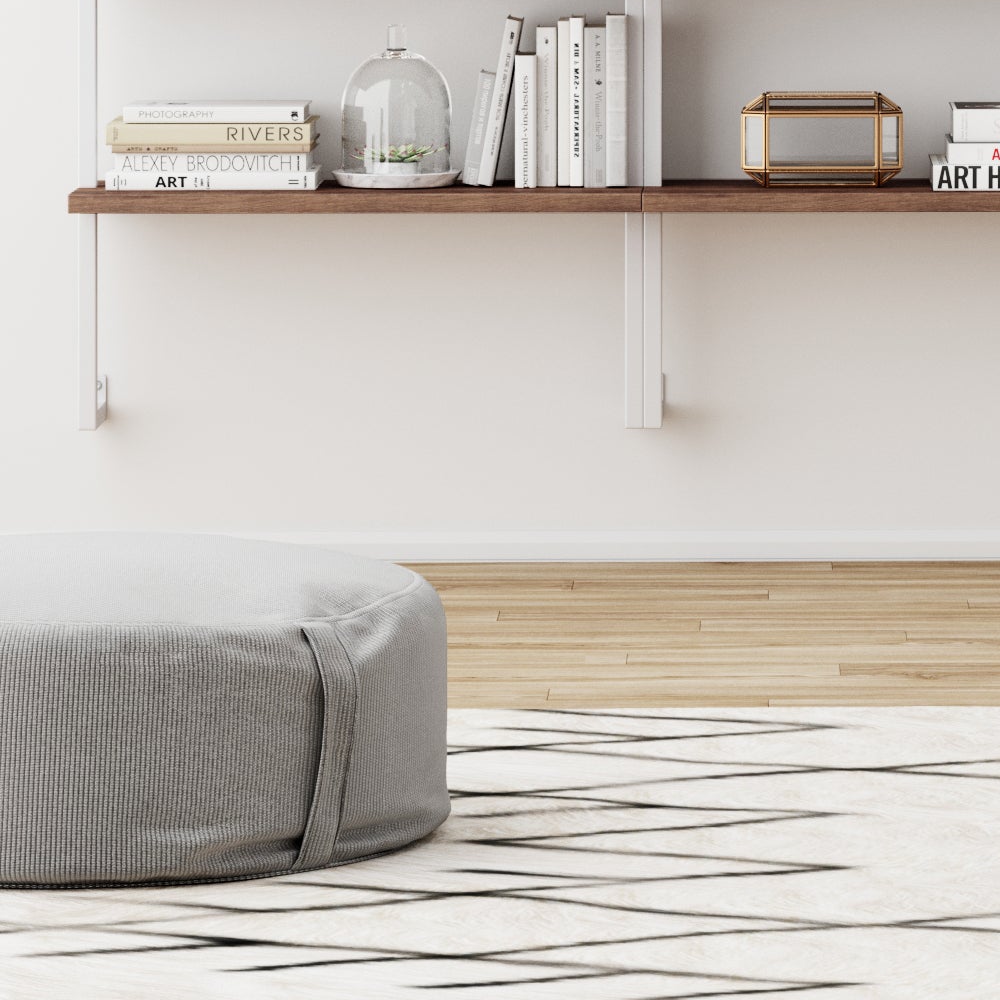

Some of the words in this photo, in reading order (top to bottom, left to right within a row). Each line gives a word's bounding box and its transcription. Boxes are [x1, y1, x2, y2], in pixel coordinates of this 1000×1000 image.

[227, 127, 304, 141] RIVERS
[122, 155, 178, 172] ALEXEY
[187, 155, 292, 172] BRODOVITCH
[155, 176, 188, 188] ART
[937, 165, 981, 190] ART
